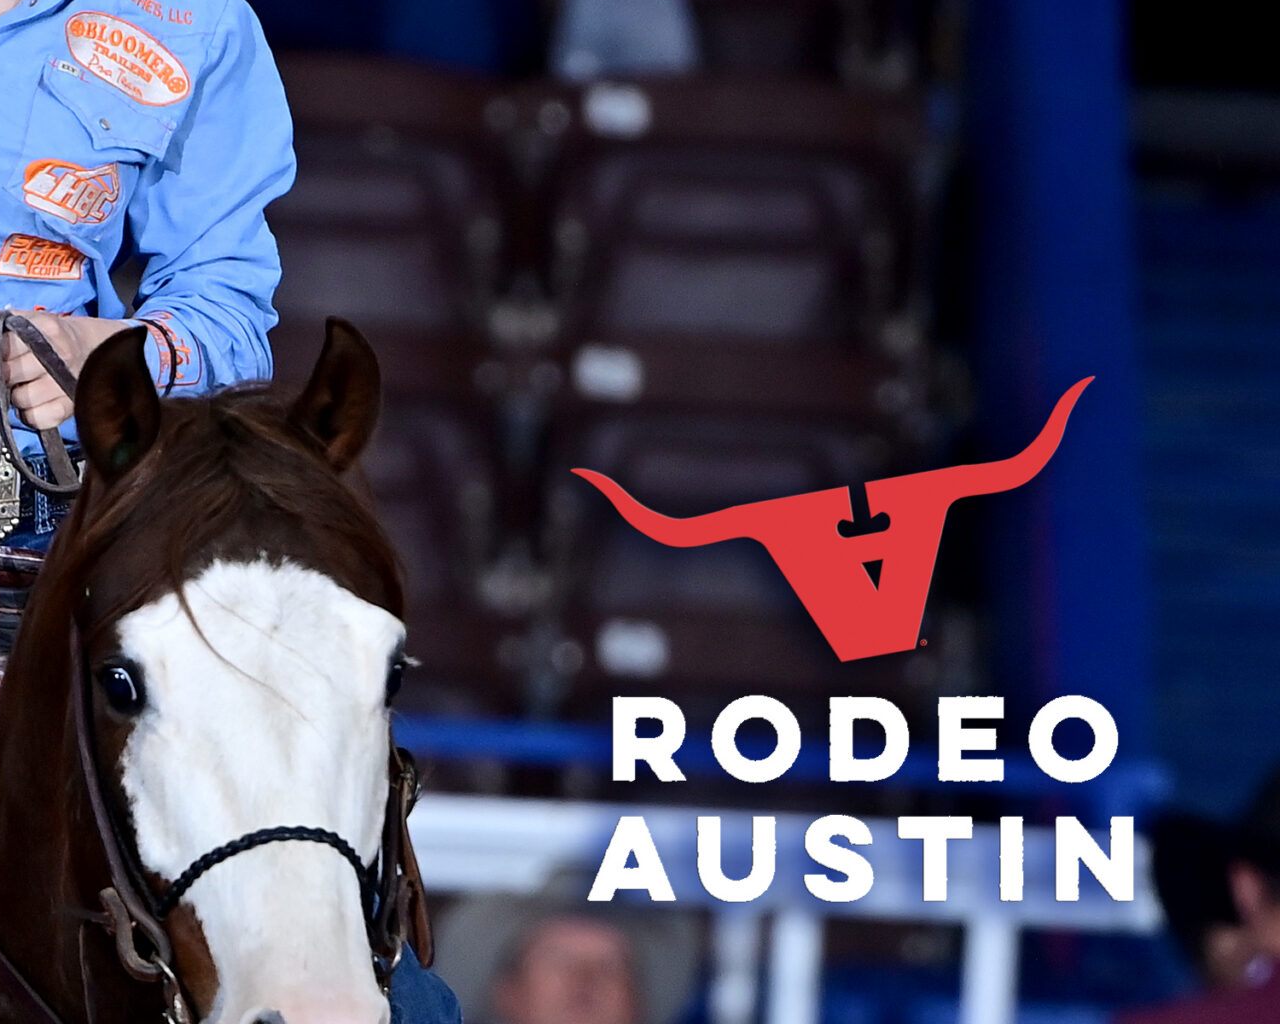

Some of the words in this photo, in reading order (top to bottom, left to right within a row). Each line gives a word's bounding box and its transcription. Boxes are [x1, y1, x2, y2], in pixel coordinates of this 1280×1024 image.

[168, 8, 193, 25] LLC
[84, 21, 174, 85] BLOOMER
[93, 41, 154, 83] TRAILERS
